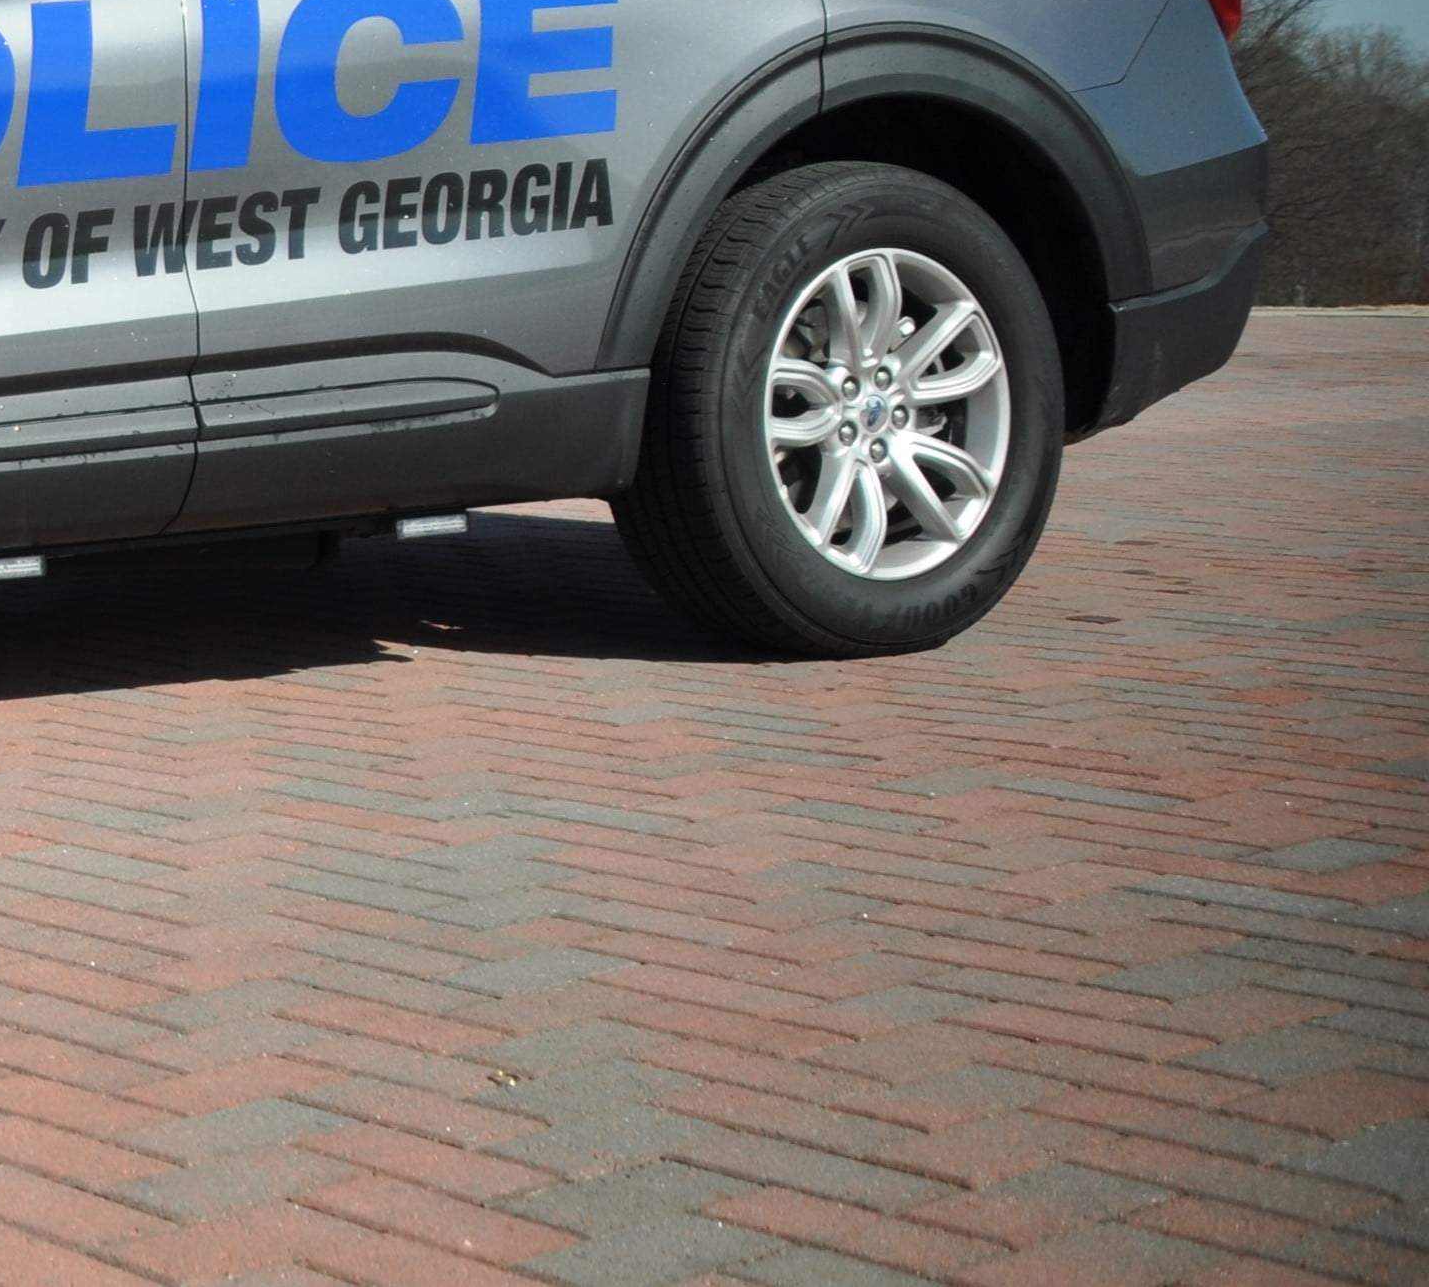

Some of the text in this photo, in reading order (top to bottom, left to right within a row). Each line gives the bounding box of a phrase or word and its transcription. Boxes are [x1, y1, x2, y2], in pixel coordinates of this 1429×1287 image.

[22, 208, 116, 290] OF
[133, 187, 322, 278] WEST
[338, 158, 615, 255] GEORGIA
